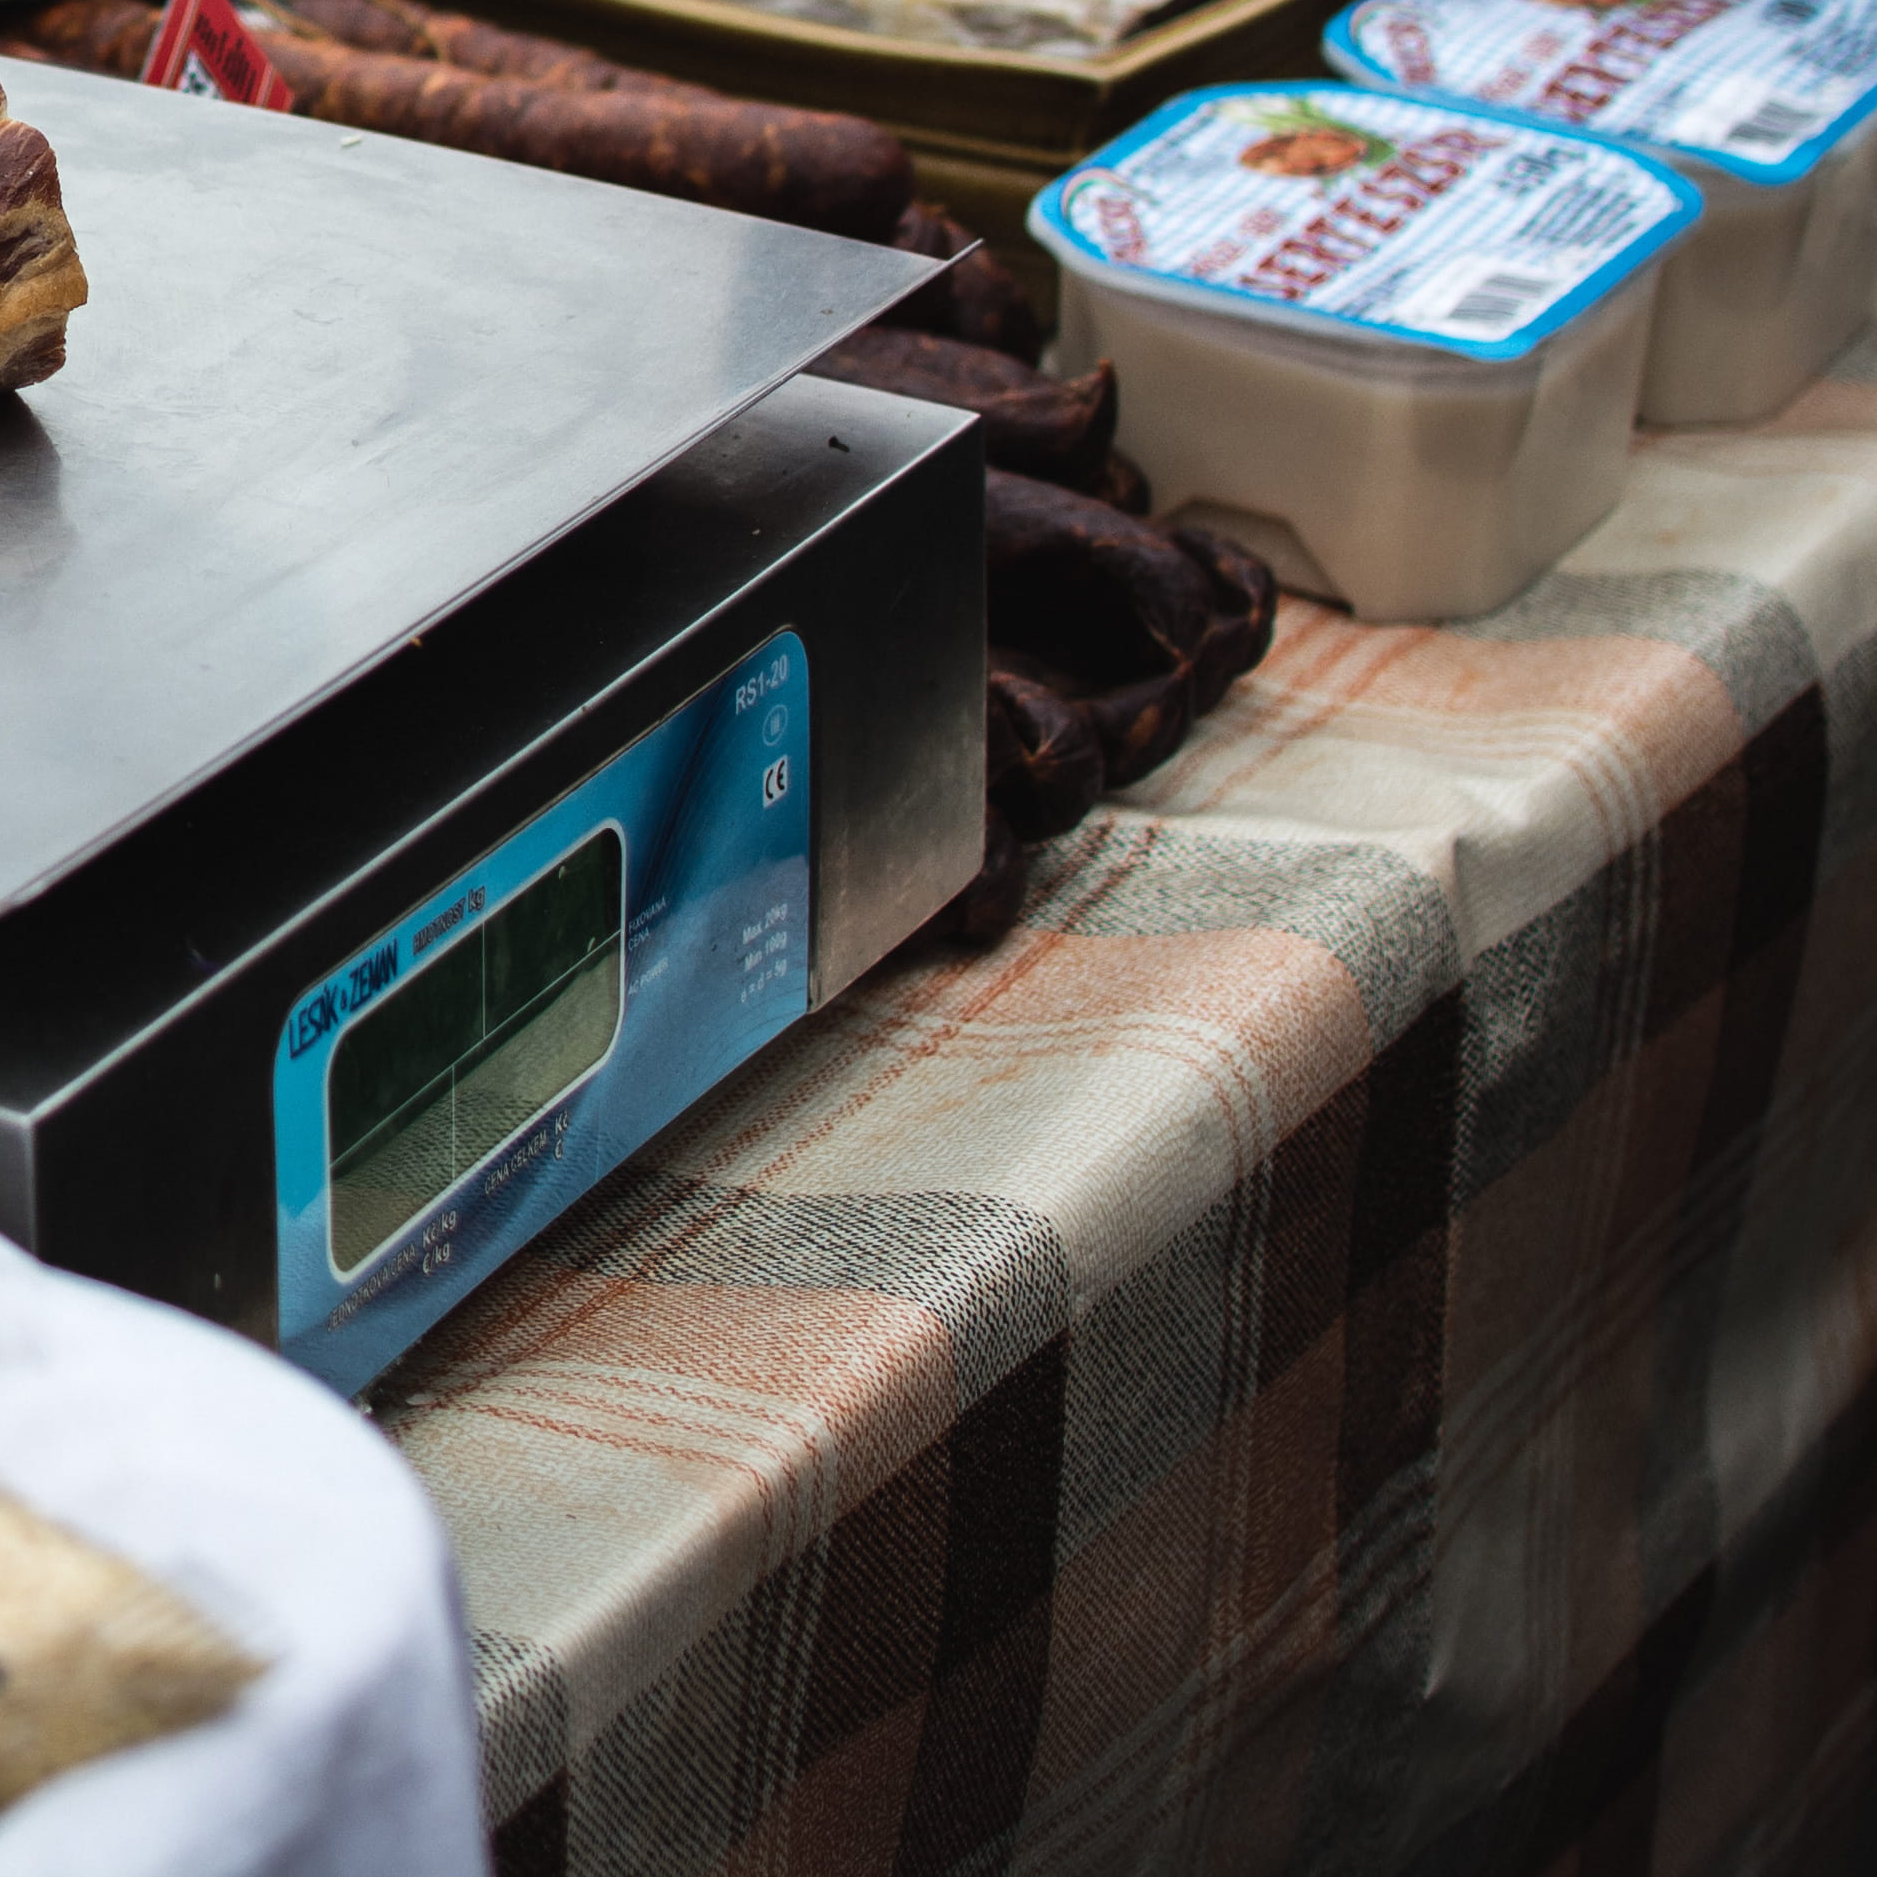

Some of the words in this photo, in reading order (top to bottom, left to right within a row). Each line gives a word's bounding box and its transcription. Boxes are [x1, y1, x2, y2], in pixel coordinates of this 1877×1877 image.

[735, 654, 788, 716] RS1-20
[764, 759, 786, 801] CE
[467, 885, 486, 915] kg
[627, 927, 651, 952] CENA
[742, 924, 763, 946] Max
[349, 938, 398, 1013] ZEMAN
[640, 956, 669, 987] POWER
[744, 950, 763, 973] Min
[483, 1164, 510, 1196] CENA
[510, 1130, 548, 1175] CELKEM
[553, 1109, 569, 1137] Kč
[390, 1241, 417, 1278] CENA
